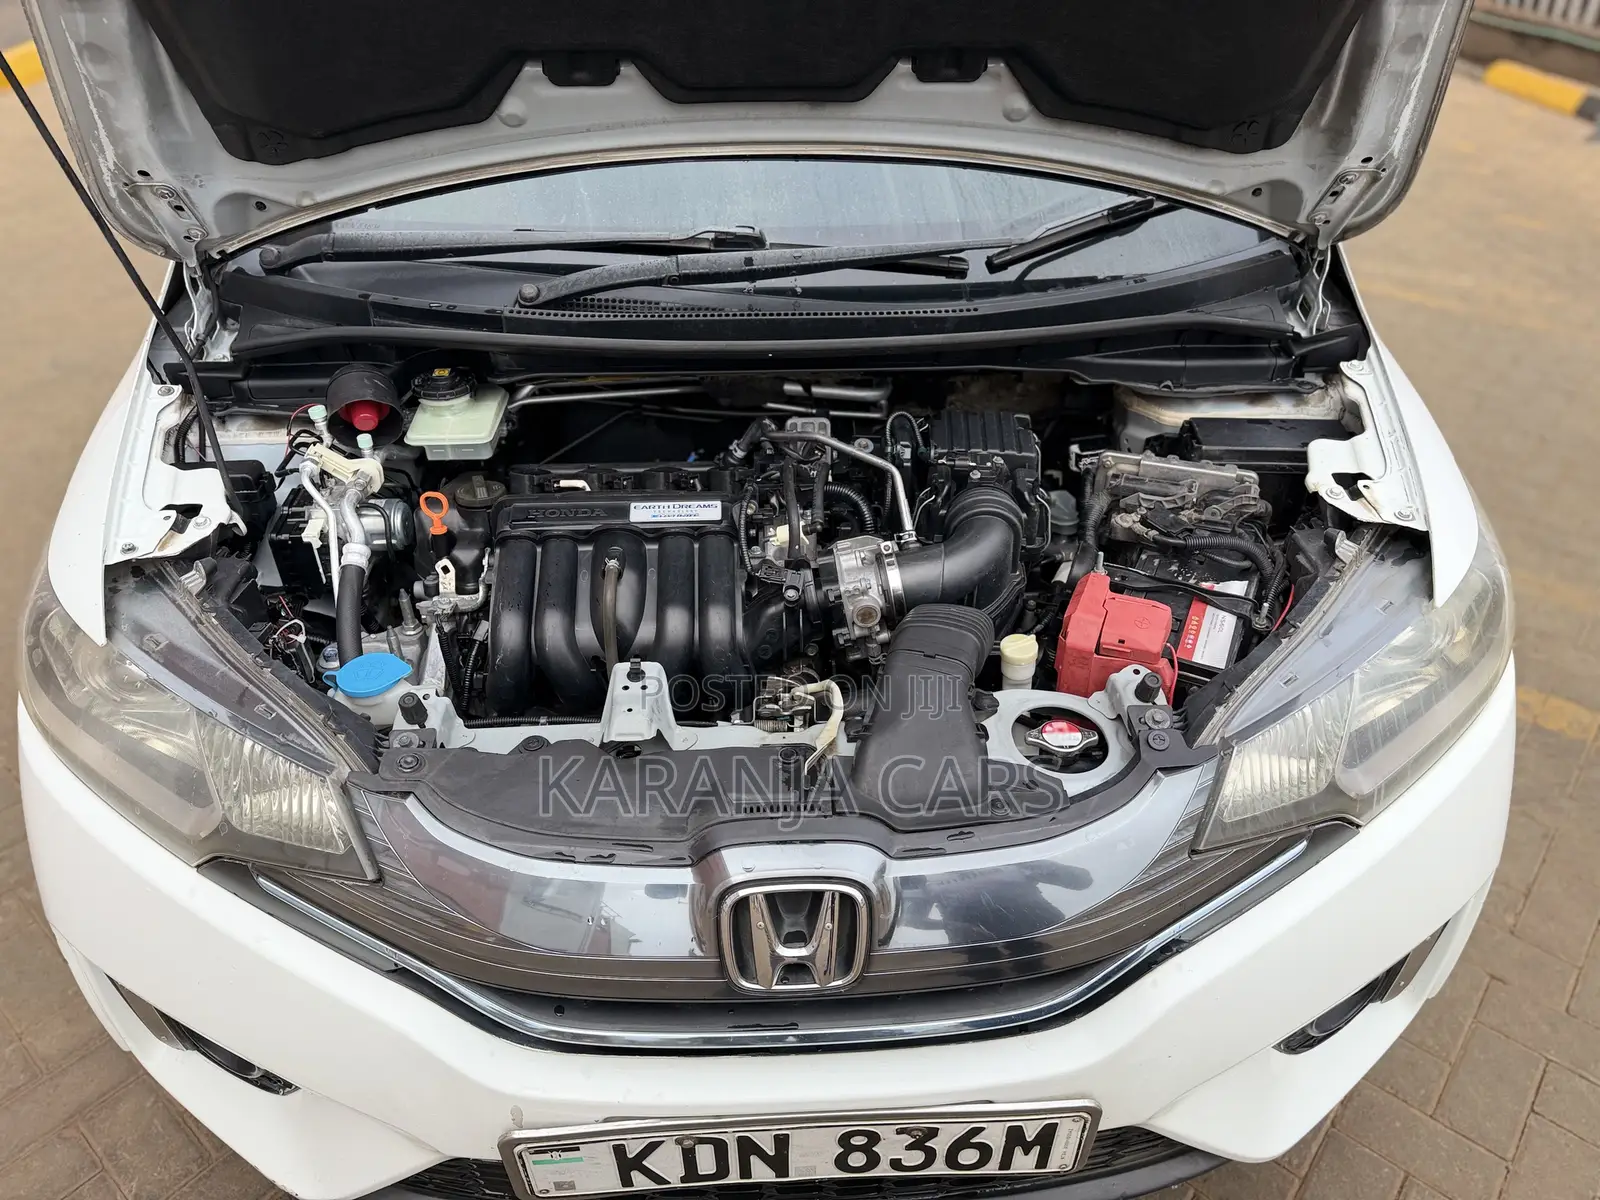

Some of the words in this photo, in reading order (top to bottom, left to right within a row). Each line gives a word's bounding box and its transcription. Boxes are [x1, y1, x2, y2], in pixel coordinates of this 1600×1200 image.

[527, 508, 608, 518] HONDA
[612, 1134, 790, 1187] KDN
[834, 1125, 1059, 1173] 836M
